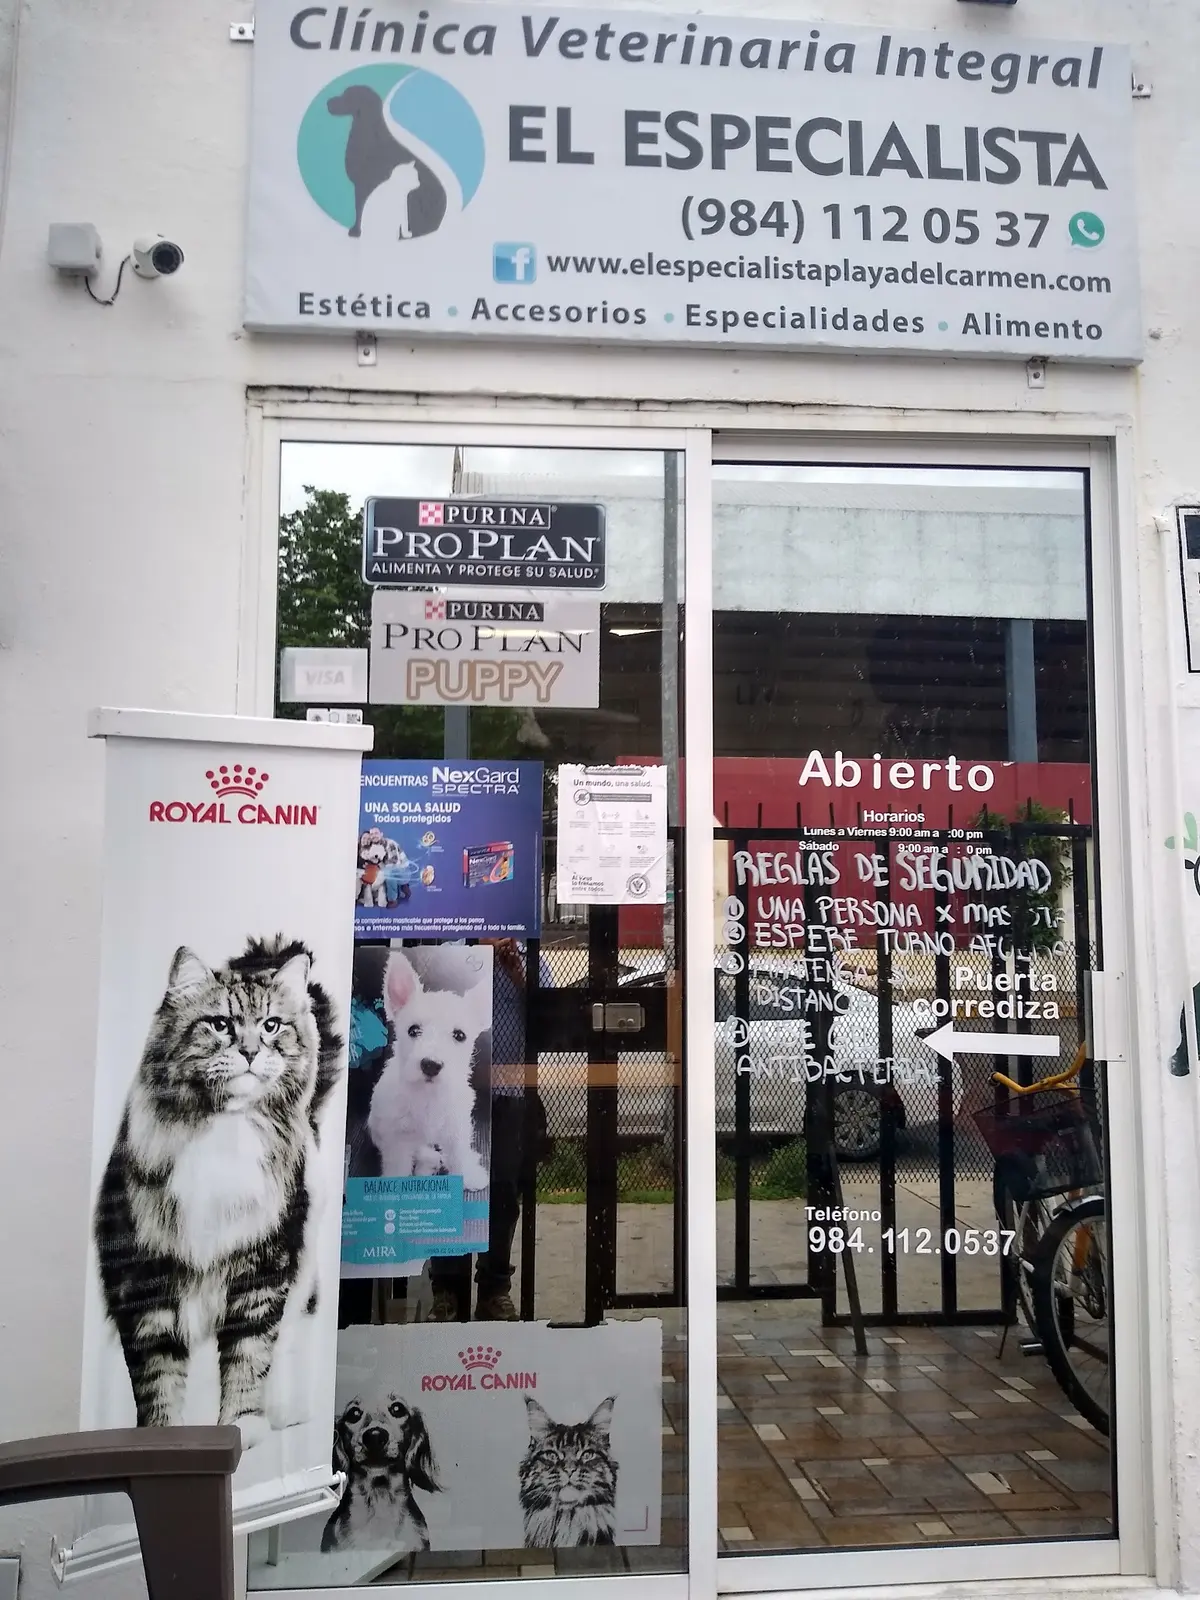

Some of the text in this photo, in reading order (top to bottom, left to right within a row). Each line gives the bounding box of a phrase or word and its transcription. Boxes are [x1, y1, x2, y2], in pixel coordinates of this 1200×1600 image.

[289, 6, 1104, 95] Clínica Veterinaria Integral
[508, 104, 1108, 191] EL ESPECIALISTA
[681, 196, 1050, 249] (984) 112 05 37
[546, 252, 1112, 294] www.elespecialistaplayadelcarmen.com
[299, 292, 1103, 341] Estética Accesorios Especialidades Alimento
[447, 506, 546, 526] PURINA
[372, 562, 441, 575] ALIMENTA
[445, 564, 454, 575] Y
[459, 564, 521, 578] PROTEGE
[526, 566, 545, 579] SU
[450, 602, 541, 621] PURINA
[304, 669, 346, 687] VISA
[407, 658, 564, 702] PUPPY
[432, 766, 520, 784] NexGard
[798, 750, 995, 792] Abierto
[432, 784, 520, 795] SPECTRA
[573, 779, 584, 787] Un
[585, 779, 614, 788] mundo,
[631, 780, 653, 788] salud.
[150, 801, 318, 825] ROYAL CANIN
[365, 802, 461, 813] UNA SOLA SALUD
[863, 809, 926, 823] Horarios
[374, 814, 452, 825] Todos protegidos
[804, 826, 836, 836] Lunes
[837, 828, 845, 836] a
[847, 827, 887, 837] Viernes
[889, 828, 913, 837] 9:00
[914, 830, 931, 838] am
[932, 830, 940, 838] a
[966, 831, 984, 841] pm
[798, 840, 840, 851] Sábado
[898, 844, 922, 853] 9:00
[923, 846, 940, 854] am
[941, 846, 949, 854] a
[975, 846, 992, 856] pm
[732, 850, 1052, 894] REGLAS DE SEGURIDAD
[757, 895, 806, 923] UNA
[815, 895, 923, 928] PERSONA
[754, 922, 861, 953] ESPERE
[876, 929, 956, 957] TURNO
[955, 965, 1058, 993] Puerta
[913, 995, 1060, 1020] corrediza
[364, 1178, 450, 1194] BALANCE NUTRICIONAL
[804, 1206, 882, 1222] Teléfono
[362, 1245, 397, 1258] MIRA
[421, 1371, 538, 1393] ROYAL CANIN
